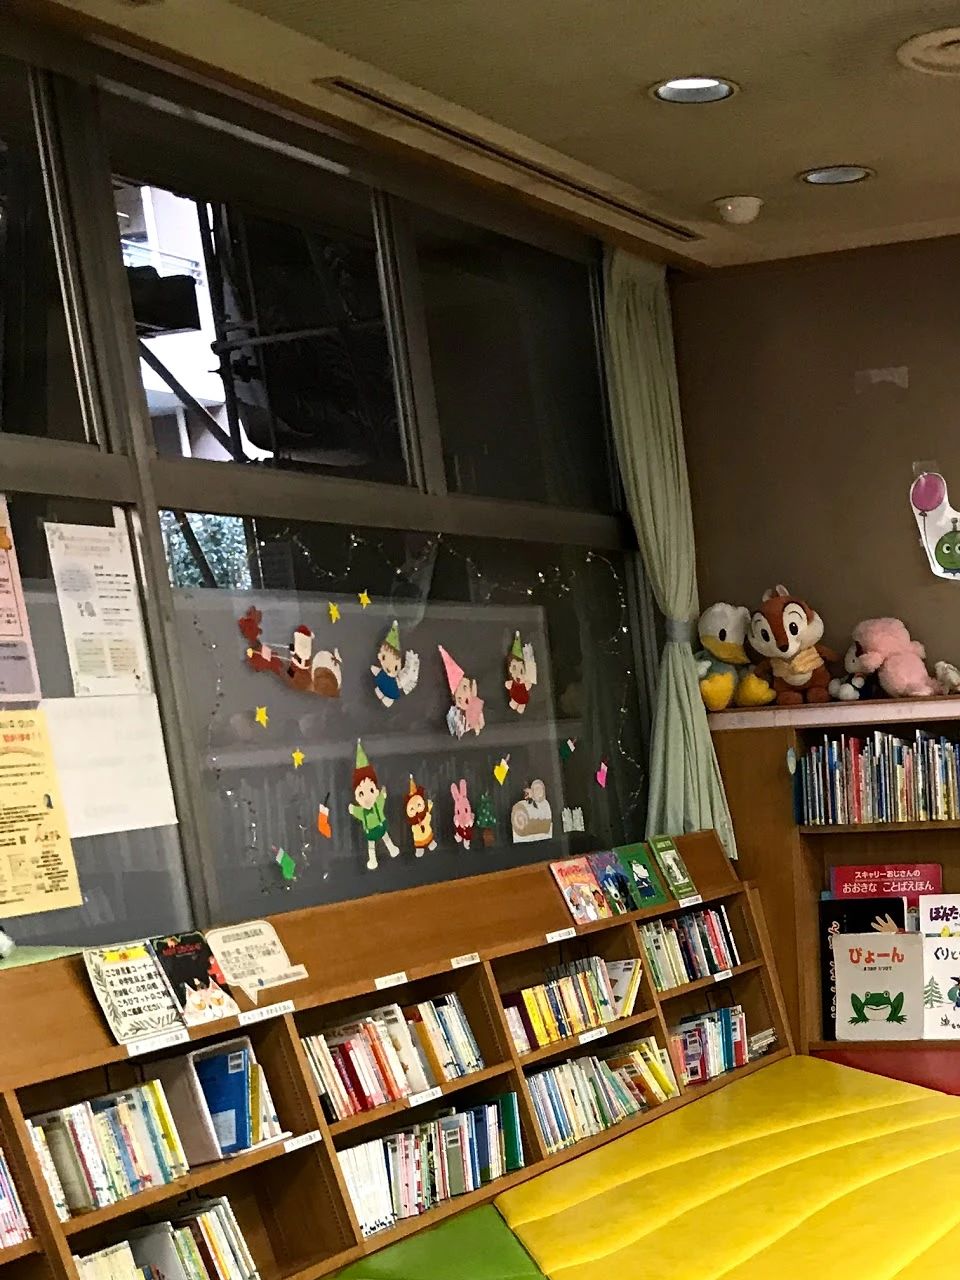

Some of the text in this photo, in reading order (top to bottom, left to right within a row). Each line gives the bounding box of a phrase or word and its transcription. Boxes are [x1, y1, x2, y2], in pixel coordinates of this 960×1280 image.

[854, 869, 920, 880] スキャリーおじさんの
[842, 880, 934, 894] おおきな ことばえほん
